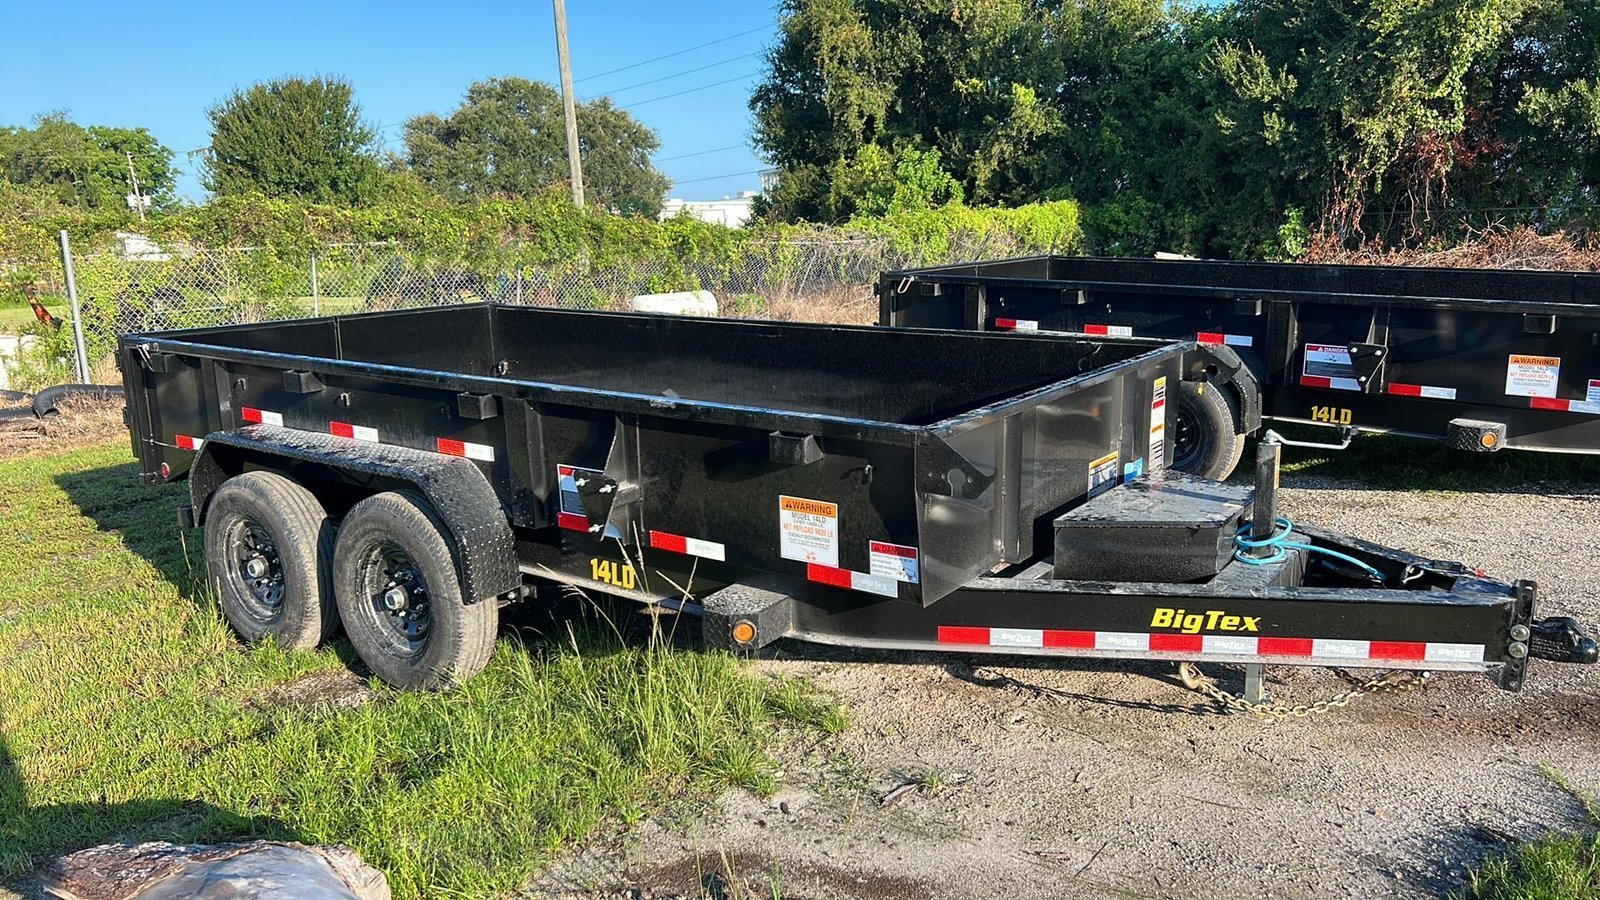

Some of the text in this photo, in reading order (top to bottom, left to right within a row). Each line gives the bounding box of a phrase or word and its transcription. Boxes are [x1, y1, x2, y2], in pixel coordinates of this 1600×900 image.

[1311, 405, 1352, 425] 14LD
[793, 501, 832, 515] WARNING
[791, 511, 826, 524] MODEL 14LD
[784, 522, 792, 530] NET
[793, 524, 814, 534] PAYLOAD
[804, 534, 831, 544] DISTRIBUTED
[884, 546, 912, 556] DANGER
[590, 558, 636, 590] 14LD
[1150, 608, 1261, 634] BigTex
[1000, 632, 1032, 643] BigTex
